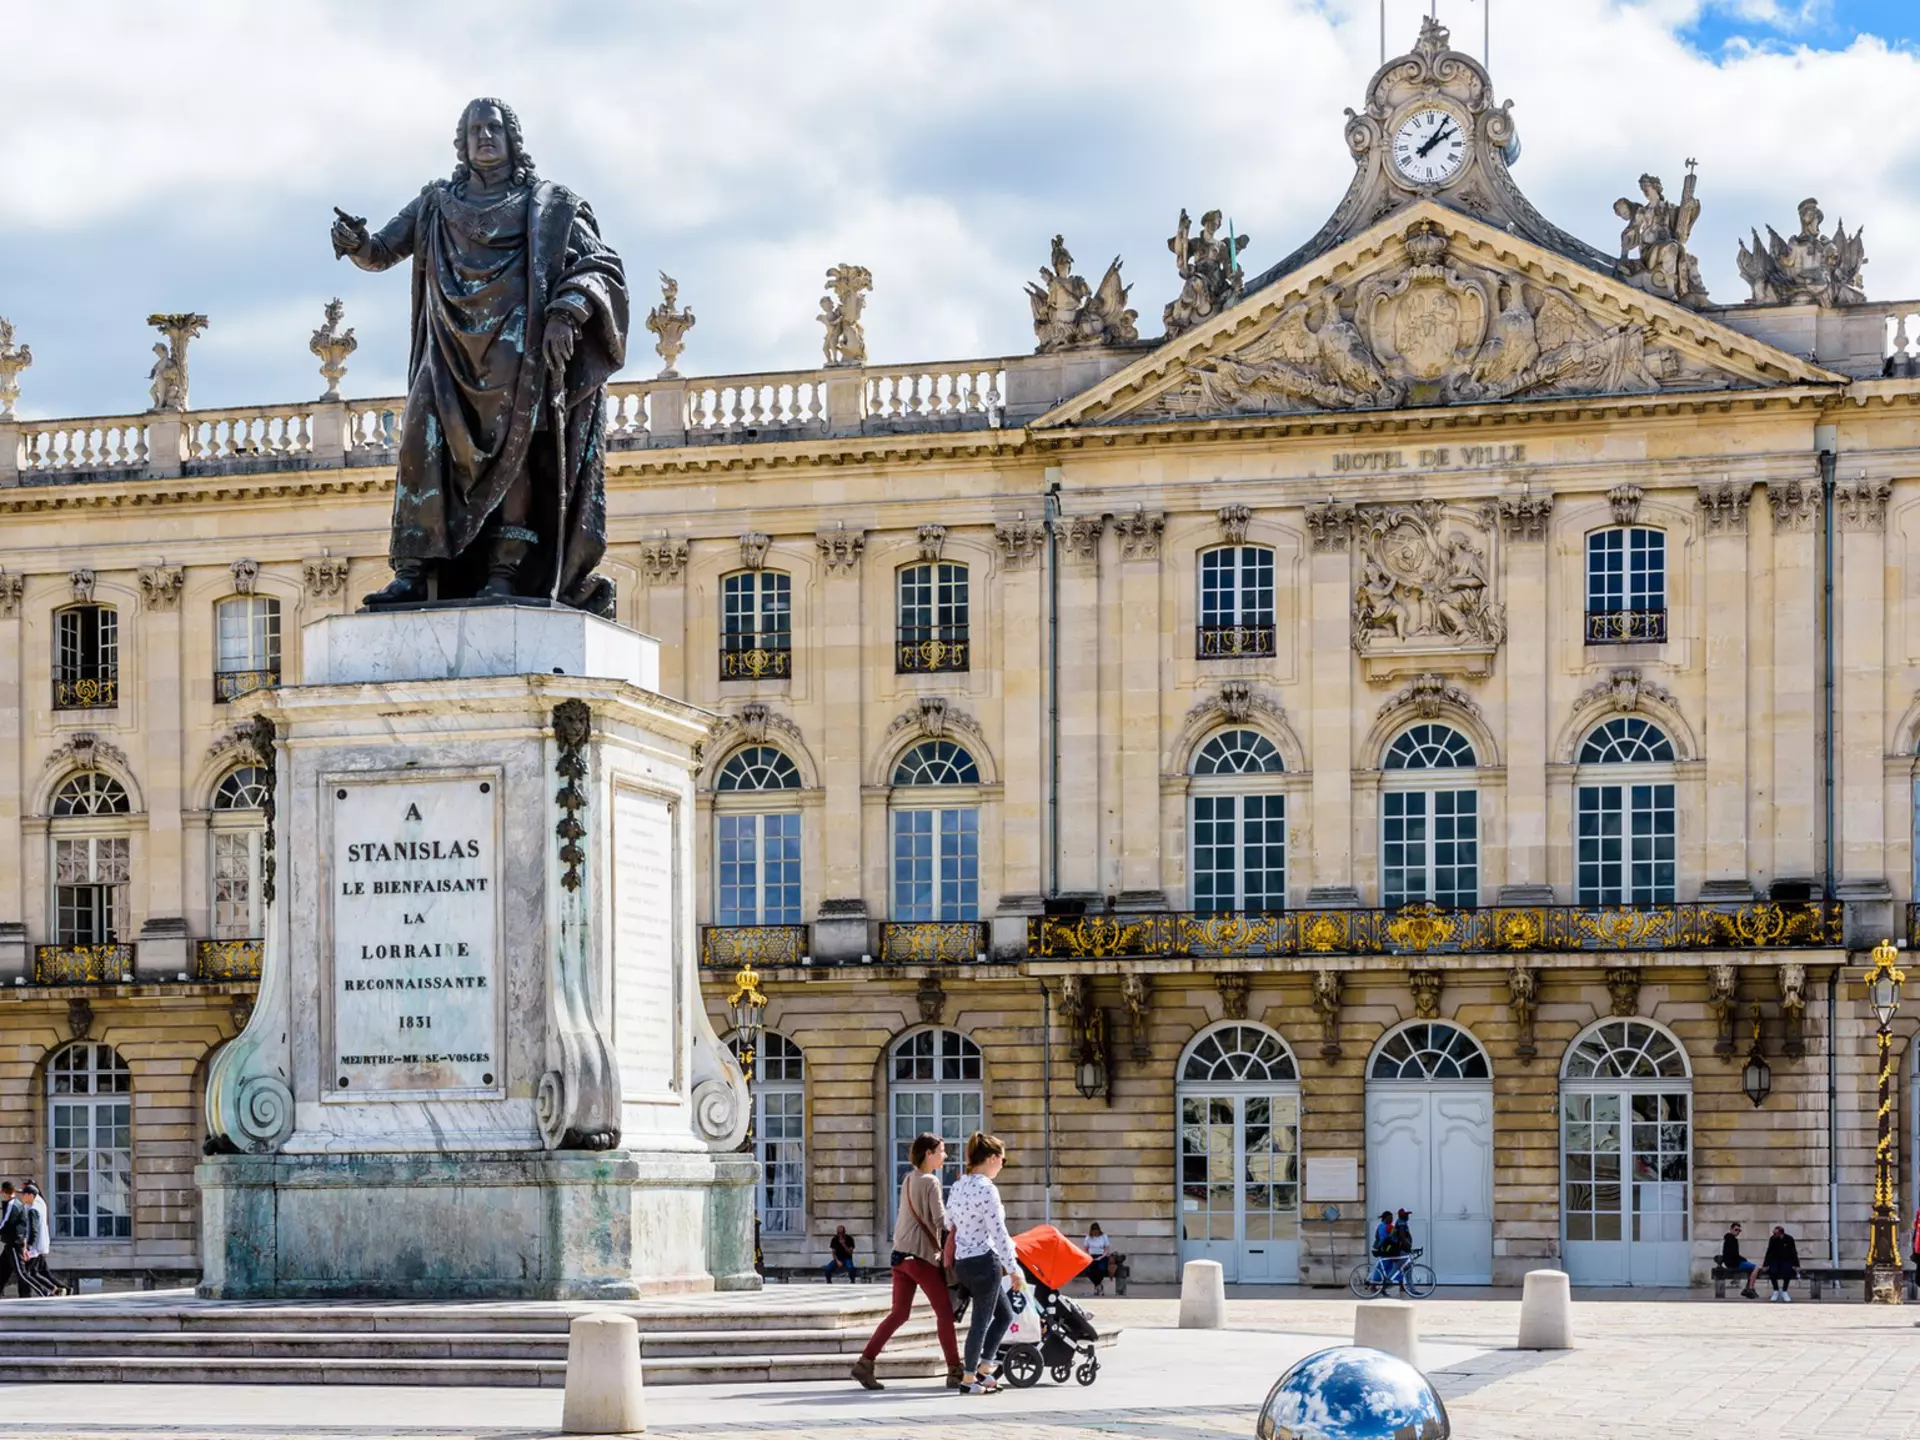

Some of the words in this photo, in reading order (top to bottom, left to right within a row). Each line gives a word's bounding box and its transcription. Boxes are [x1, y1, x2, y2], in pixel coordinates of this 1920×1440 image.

[1419, 448, 1450, 467] DE
[1460, 444, 1526, 465] VILLE
[405, 802, 422, 821] A
[348, 839, 480, 862] STANISLAS
[342, 882, 365, 896] LE
[373, 878, 487, 894] BIENFAISANT
[403, 913, 425, 924] LA
[344, 976, 487, 991] RECONNAISSANTE
[399, 1016, 431, 1028] 1831
